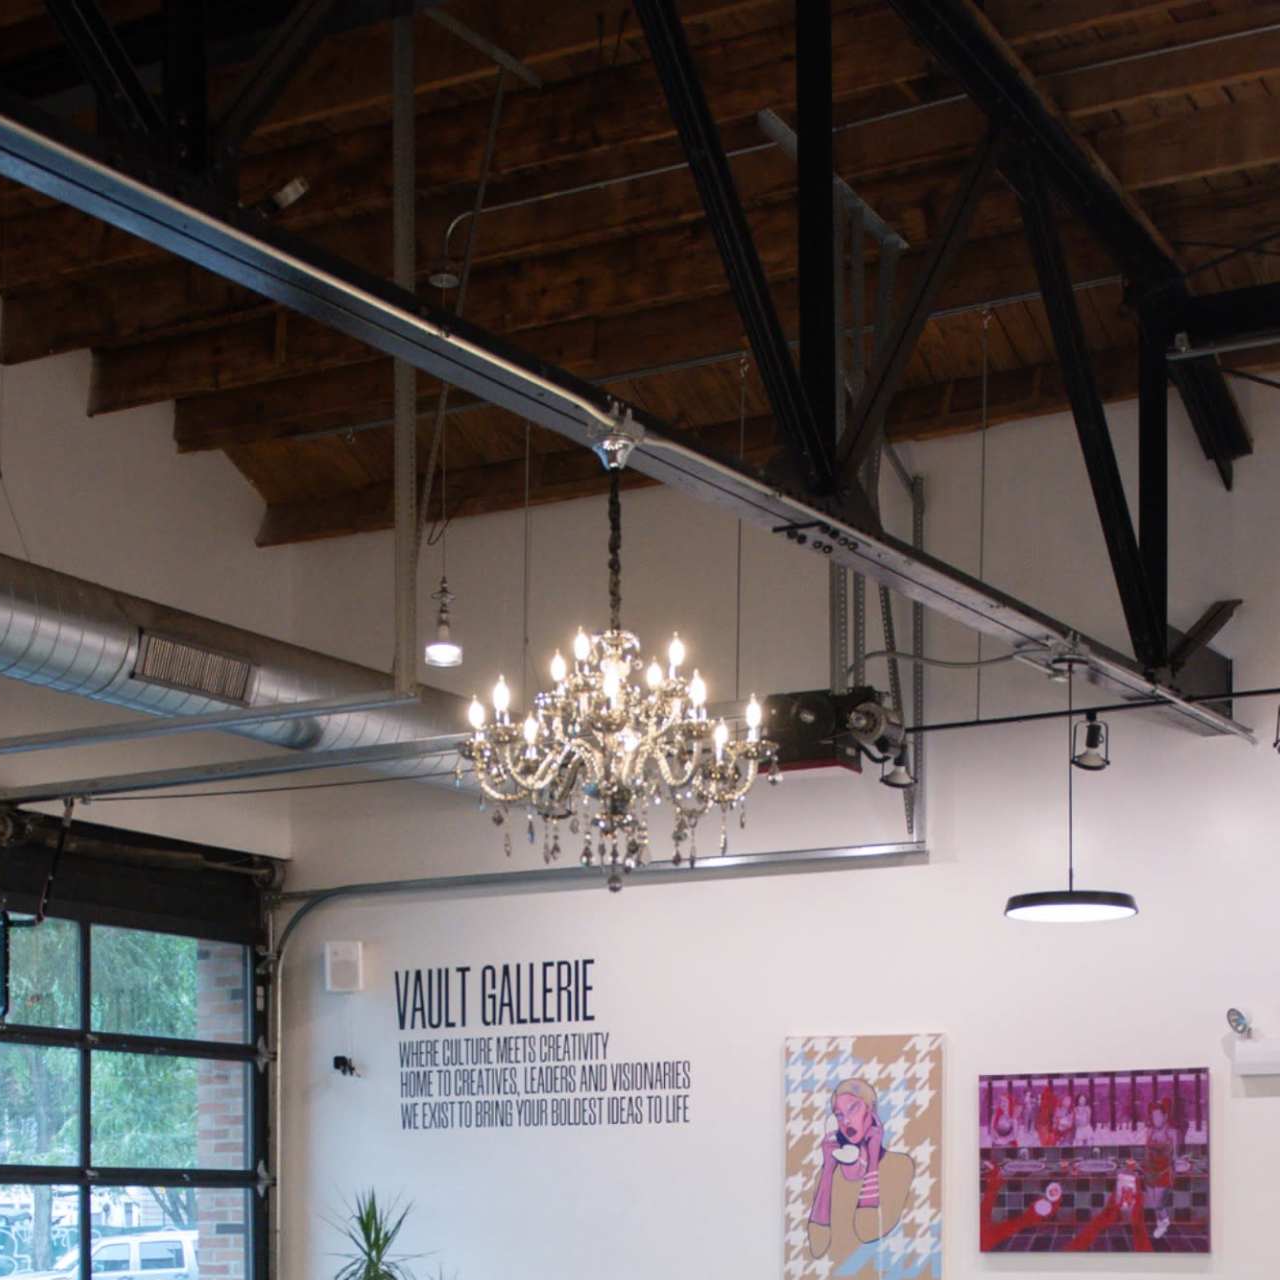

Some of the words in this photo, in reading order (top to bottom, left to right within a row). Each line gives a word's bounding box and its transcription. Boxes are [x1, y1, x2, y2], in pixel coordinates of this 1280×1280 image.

[394, 966, 471, 1030] VAULT
[481, 959, 595, 1026] GALLERIE
[399, 1039, 440, 1068] WHERE
[442, 1036, 494, 1066] CULTURE
[496, 1035, 537, 1064] MEETS
[539, 1032, 609, 1062] CREATIVITY
[400, 1069, 433, 1098] HOME
[436, 1068, 451, 1097] TO
[454, 1067, 520, 1097] CREATIVES,
[524, 1065, 577, 1094] LEADERS
[579, 1064, 607, 1092] AND
[610, 1061, 691, 1091] VISIONARIES
[401, 1102, 420, 1130] WE
[422, 1101, 457, 1129] EXIST
[457, 1100, 473, 1128] TO
[475, 1099, 513, 1128] BRING
[516, 1098, 548, 1127] YOUR
[551, 1097, 603, 1126] BOLDEST
[607, 1096, 643, 1125] IDEAS
[646, 1095, 663, 1124] TO
[665, 1094, 690, 1124] LIFE
